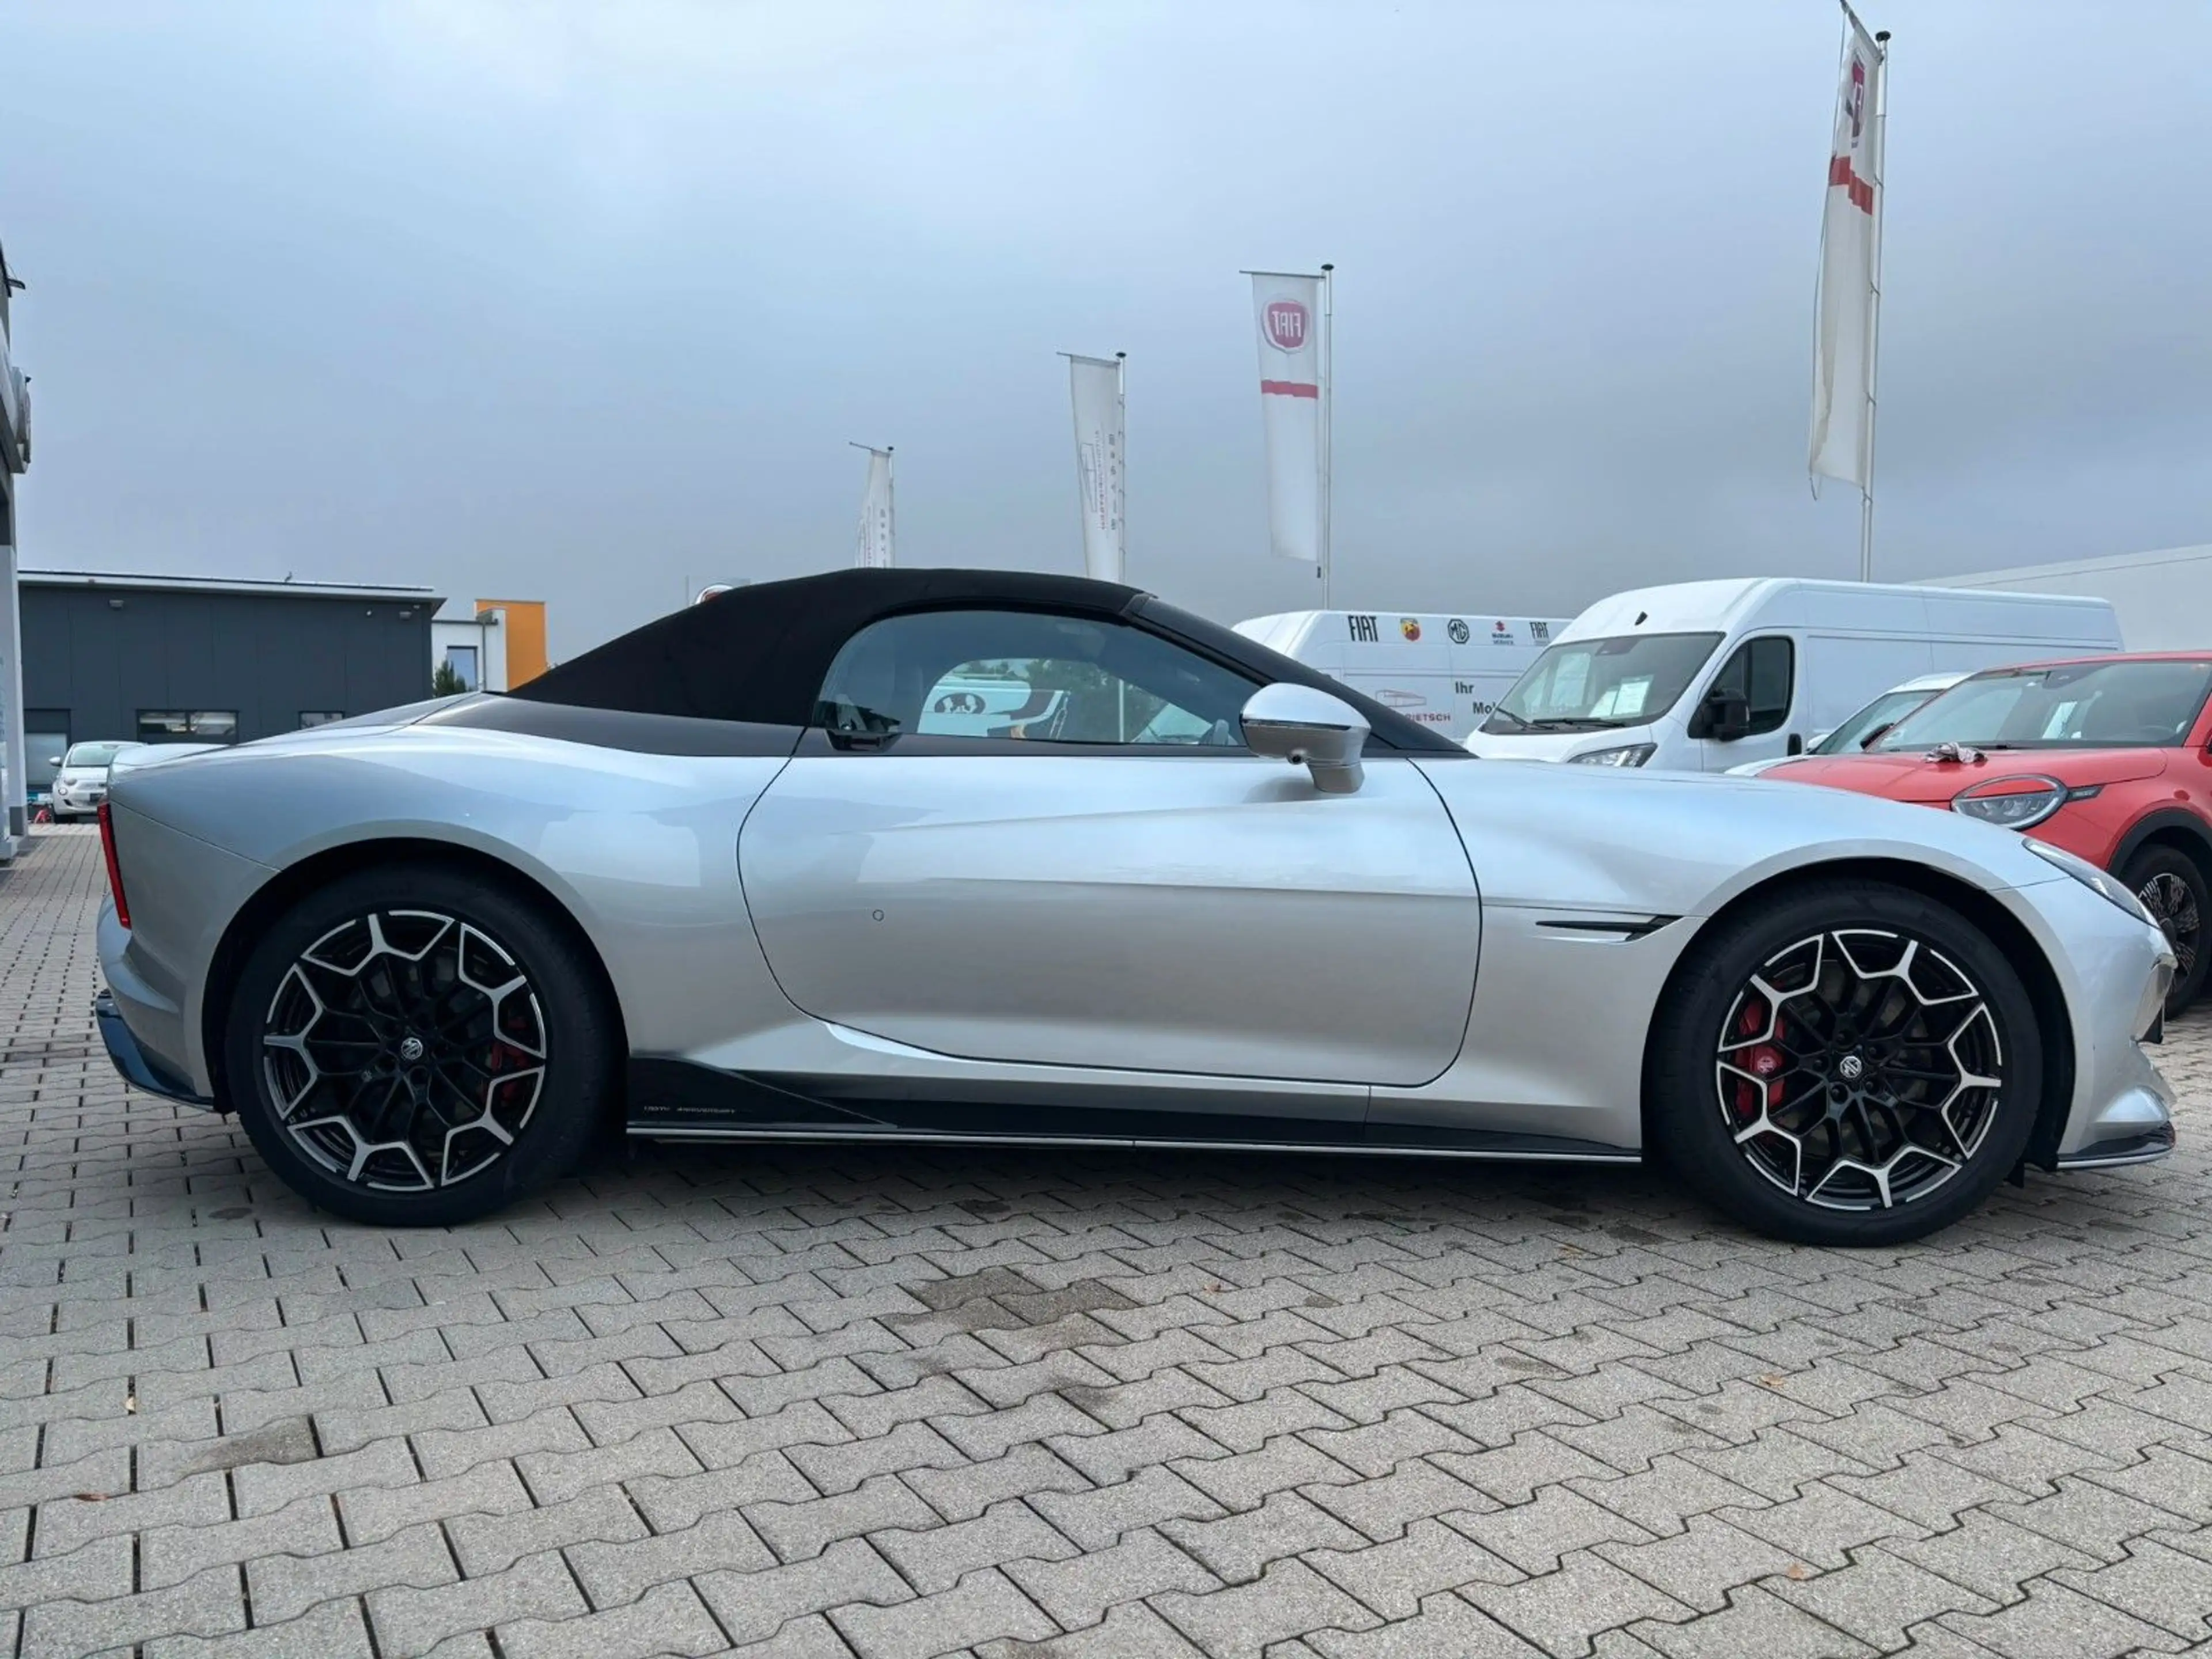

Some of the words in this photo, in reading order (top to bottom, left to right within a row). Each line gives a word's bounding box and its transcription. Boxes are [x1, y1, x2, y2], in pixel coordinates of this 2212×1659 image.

[1347, 615, 1379, 642] FIAT
[1449, 620, 1469, 643] MG
[1455, 681, 1475, 694] Ihr
